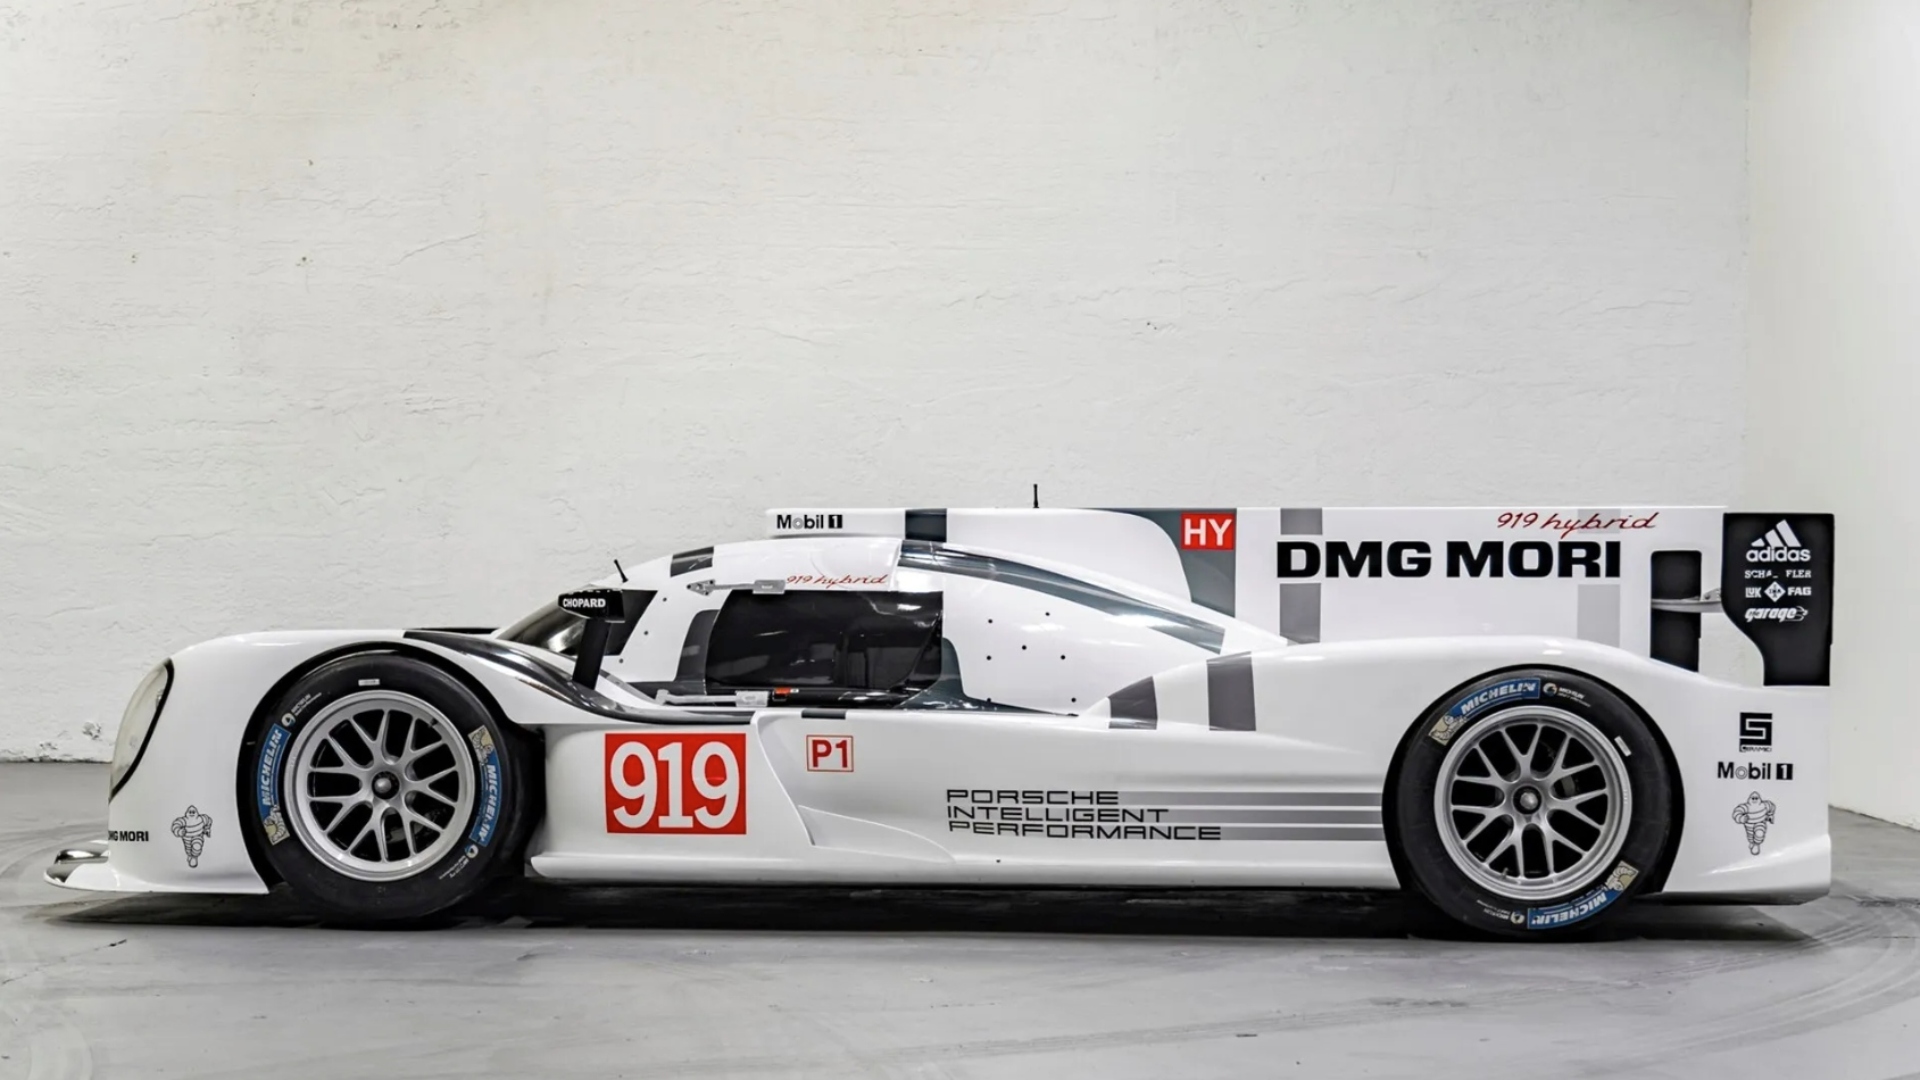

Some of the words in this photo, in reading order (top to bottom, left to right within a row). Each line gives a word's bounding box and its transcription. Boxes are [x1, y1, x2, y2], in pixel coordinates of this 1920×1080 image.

[776, 514, 824, 530] Mobil
[830, 515, 841, 529] 1
[1497, 512, 1539, 529] 919
[1540, 511, 1660, 540] hybrid
[1183, 518, 1232, 547] HY
[1276, 540, 1432, 579] DMG
[1446, 540, 1621, 579] MORI
[1745, 546, 1811, 562] adidas
[786, 574, 813, 585] 919
[813, 573, 889, 589] hybrid
[1744, 569, 1812, 579] SCHAFLER
[1787, 586, 1812, 597] FAG
[562, 598, 606, 608] CHOPARD
[1744, 607, 1799, 623] garage
[1461, 682, 1537, 715] MICHELIN
[812, 739, 849, 768] P1
[261, 728, 283, 806] MICHELIN
[1717, 761, 1771, 780] Mobil
[1778, 763, 1791, 780] 1
[610, 741, 740, 829] 919
[946, 789, 1119, 805] PORSCHE
[947, 805, 1169, 823] INTELLIGENT
[119, 830, 149, 842] MORI
[949, 820, 1221, 841] PERFORMANCE
